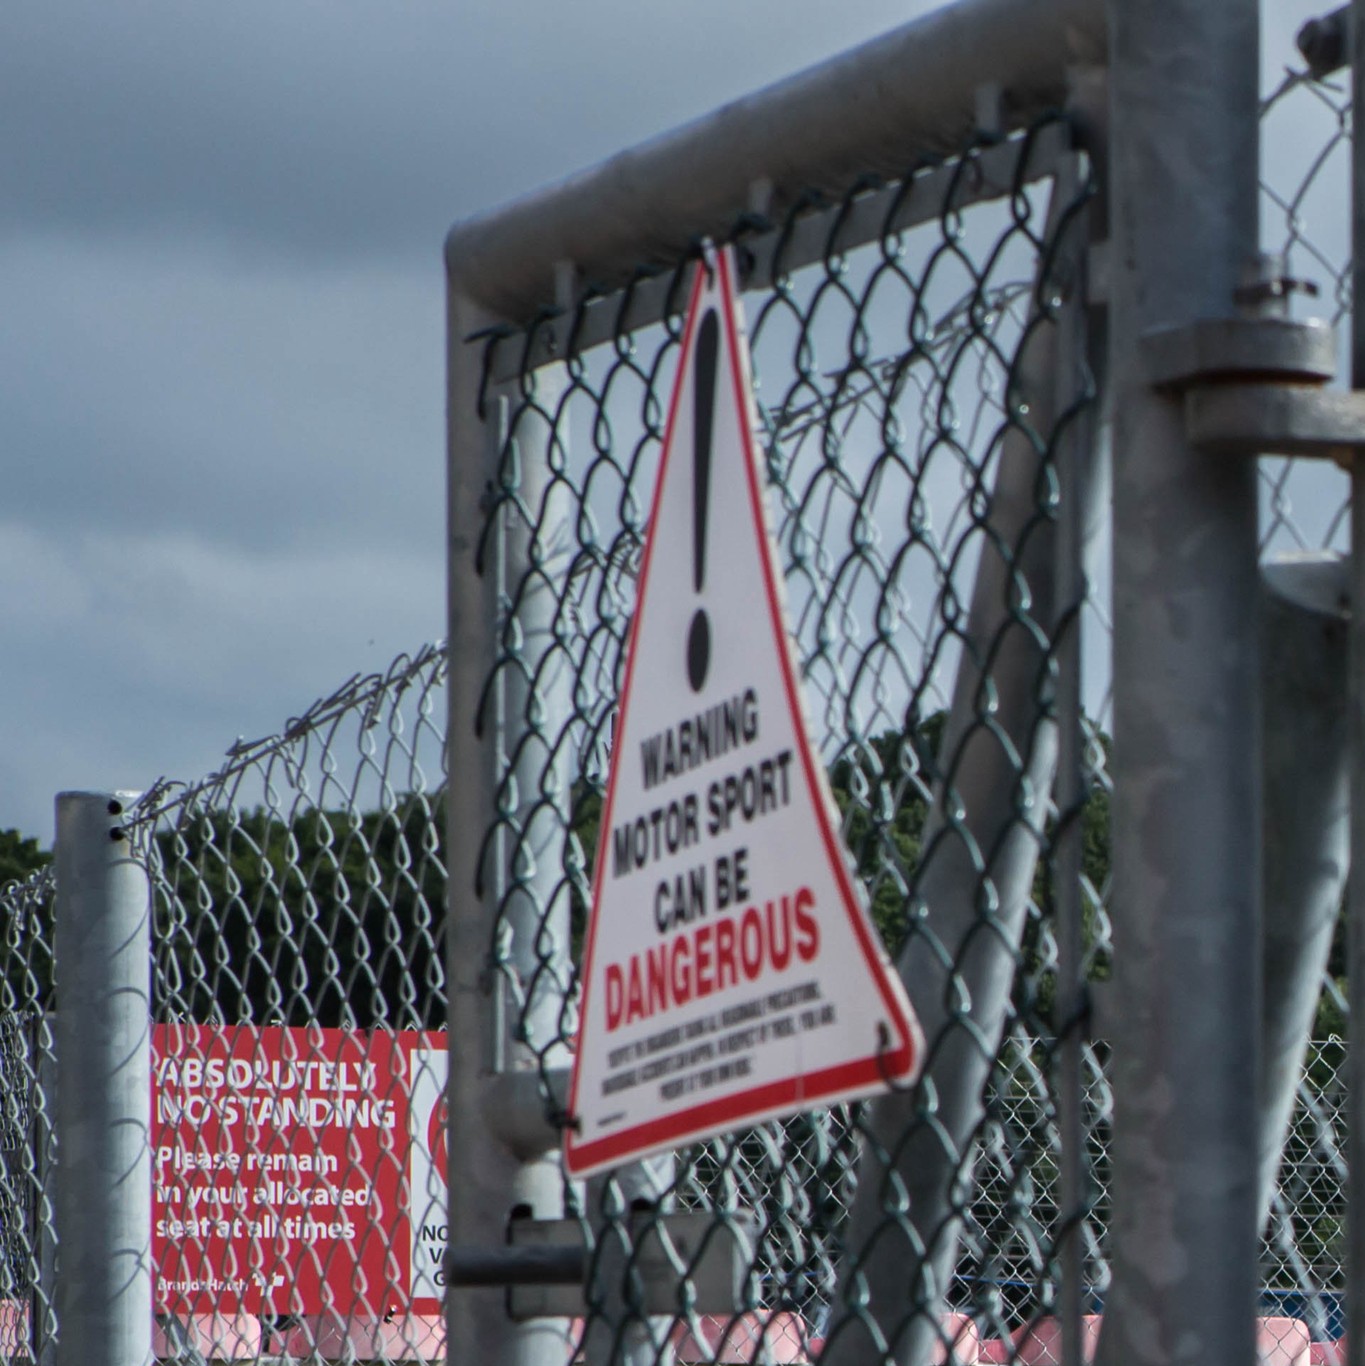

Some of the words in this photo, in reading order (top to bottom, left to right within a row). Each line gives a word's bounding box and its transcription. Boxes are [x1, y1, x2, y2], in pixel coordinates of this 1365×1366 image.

[641, 688, 758, 789] WARNING
[613, 794, 699, 878] MOTOR
[707, 750, 792, 837] SPORT
[655, 864, 706, 934] CAN
[716, 847, 749, 910] BE
[605, 886, 820, 1033] DANGEROUS
[156, 1058, 376, 1091] ABSOLUTELY
[157, 1095, 211, 1124] NO
[219, 1097, 395, 1128] STANDING
[157, 1146, 241, 1170] Please
[247, 1152, 338, 1172] remain
[156, 1183, 181, 1203] in
[188, 1185, 248, 1210] your
[253, 1181, 372, 1206] allocated
[156, 1216, 211, 1238] seat
[216, 1218, 242, 1239] at
[248, 1215, 277, 1239] all
[284, 1215, 356, 1240] times
